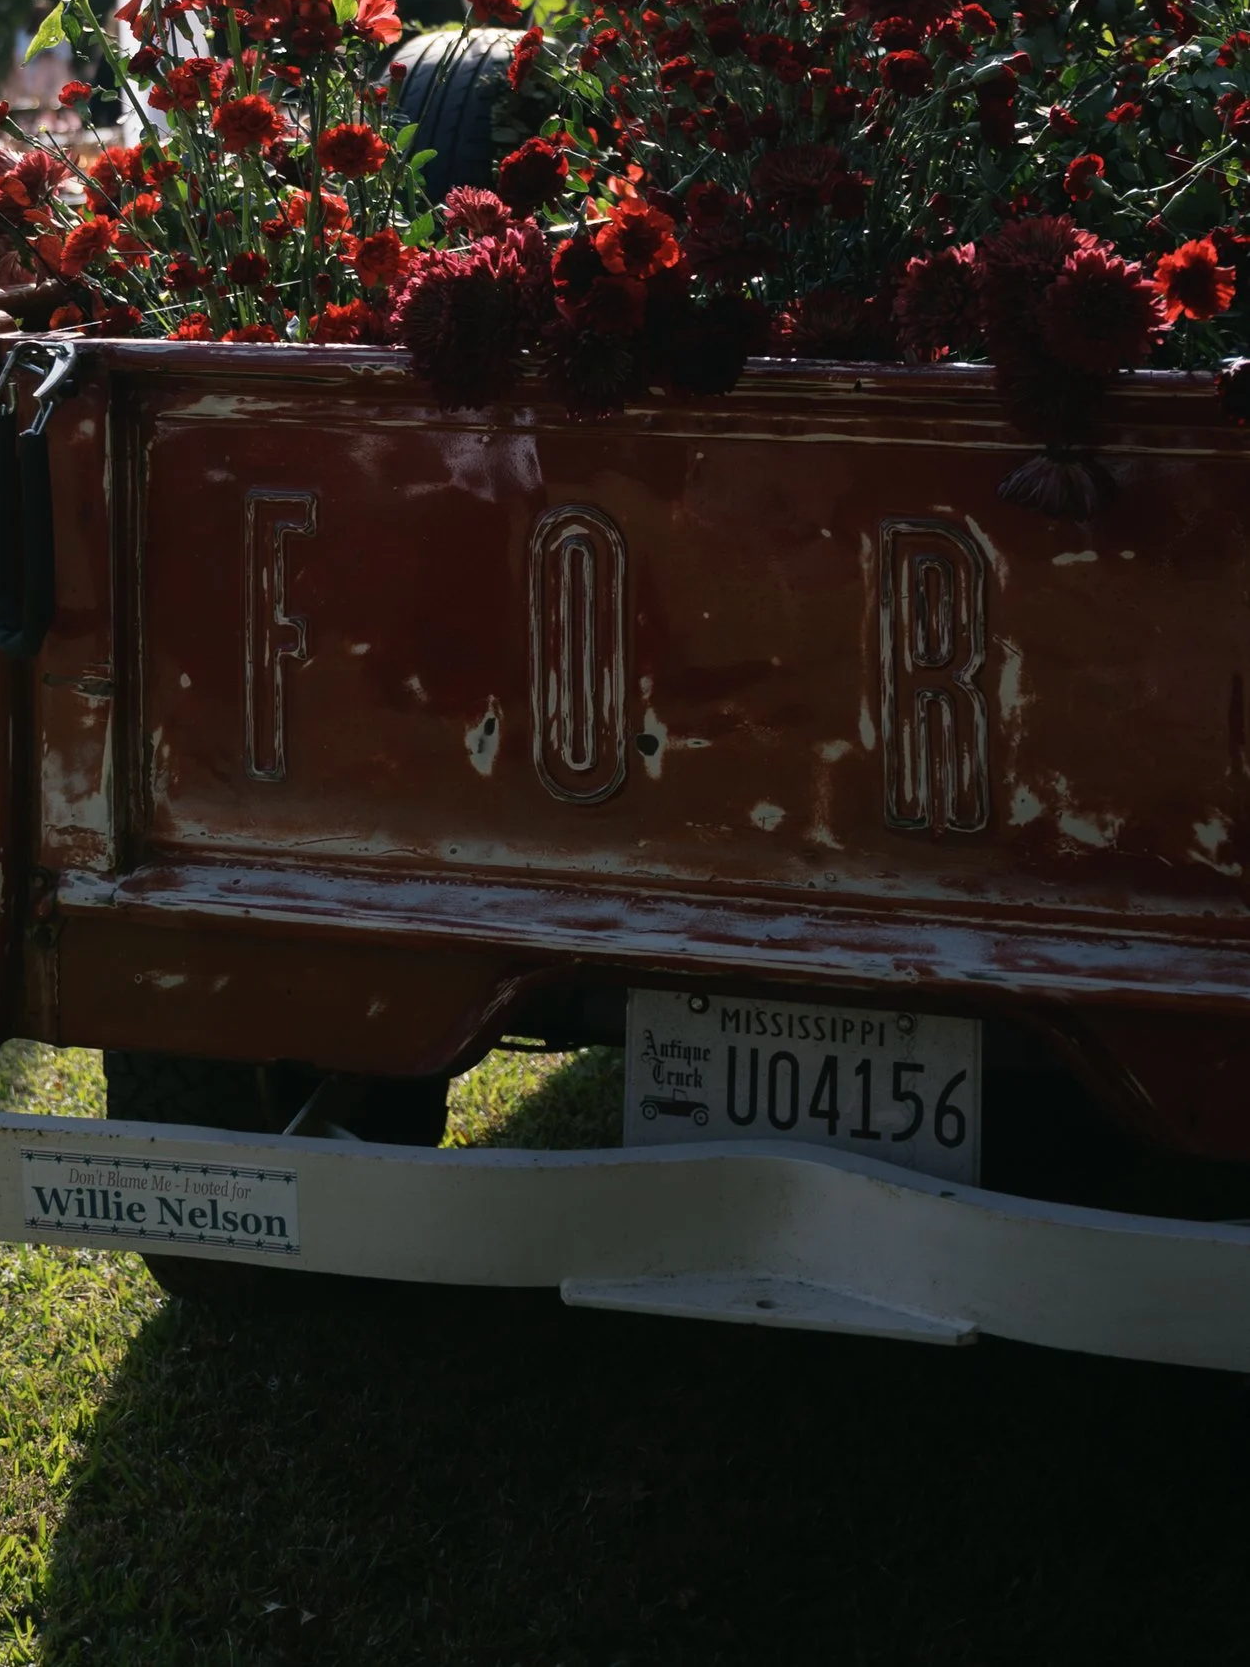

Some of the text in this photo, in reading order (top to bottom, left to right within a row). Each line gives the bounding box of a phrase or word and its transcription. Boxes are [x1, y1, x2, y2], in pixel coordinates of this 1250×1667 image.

[720, 1007, 886, 1047] MISSISSIPPI
[640, 1029, 711, 1063] Antique
[650, 1057, 703, 1090] Truck
[726, 1045, 967, 1149] U04156
[68, 1168, 105, 1186] Don't
[106, 1173, 148, 1191] Blame
[151, 1175, 173, 1193] Me
[184, 1177, 191, 1194] I
[193, 1180, 229, 1197] voted
[229, 1181, 252, 1203] for
[31, 1185, 290, 1238] Willie Nelson
